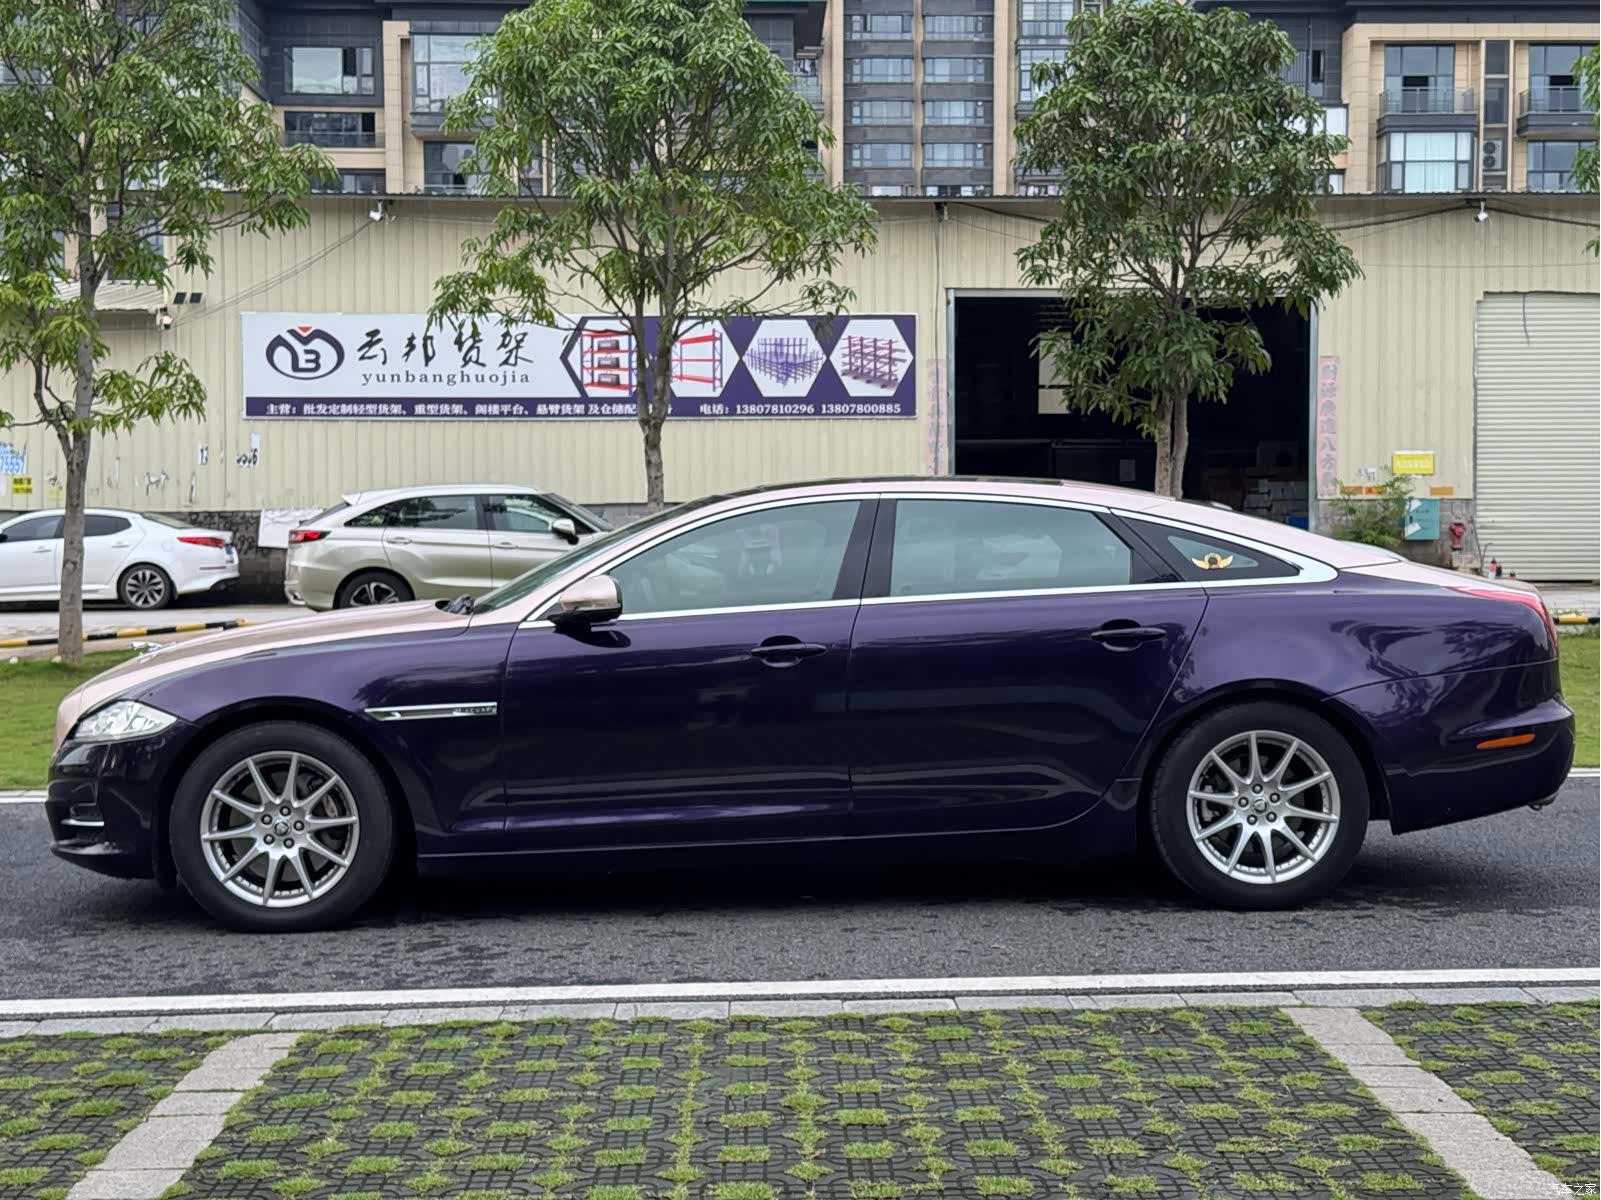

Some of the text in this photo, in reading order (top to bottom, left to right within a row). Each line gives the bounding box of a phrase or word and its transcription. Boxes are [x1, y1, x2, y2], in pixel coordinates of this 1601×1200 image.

[357, 328, 534, 368] 云邦货架
[361, 370, 530, 386] yunbanghuojia
[820, 403, 901, 414] 13807800885
